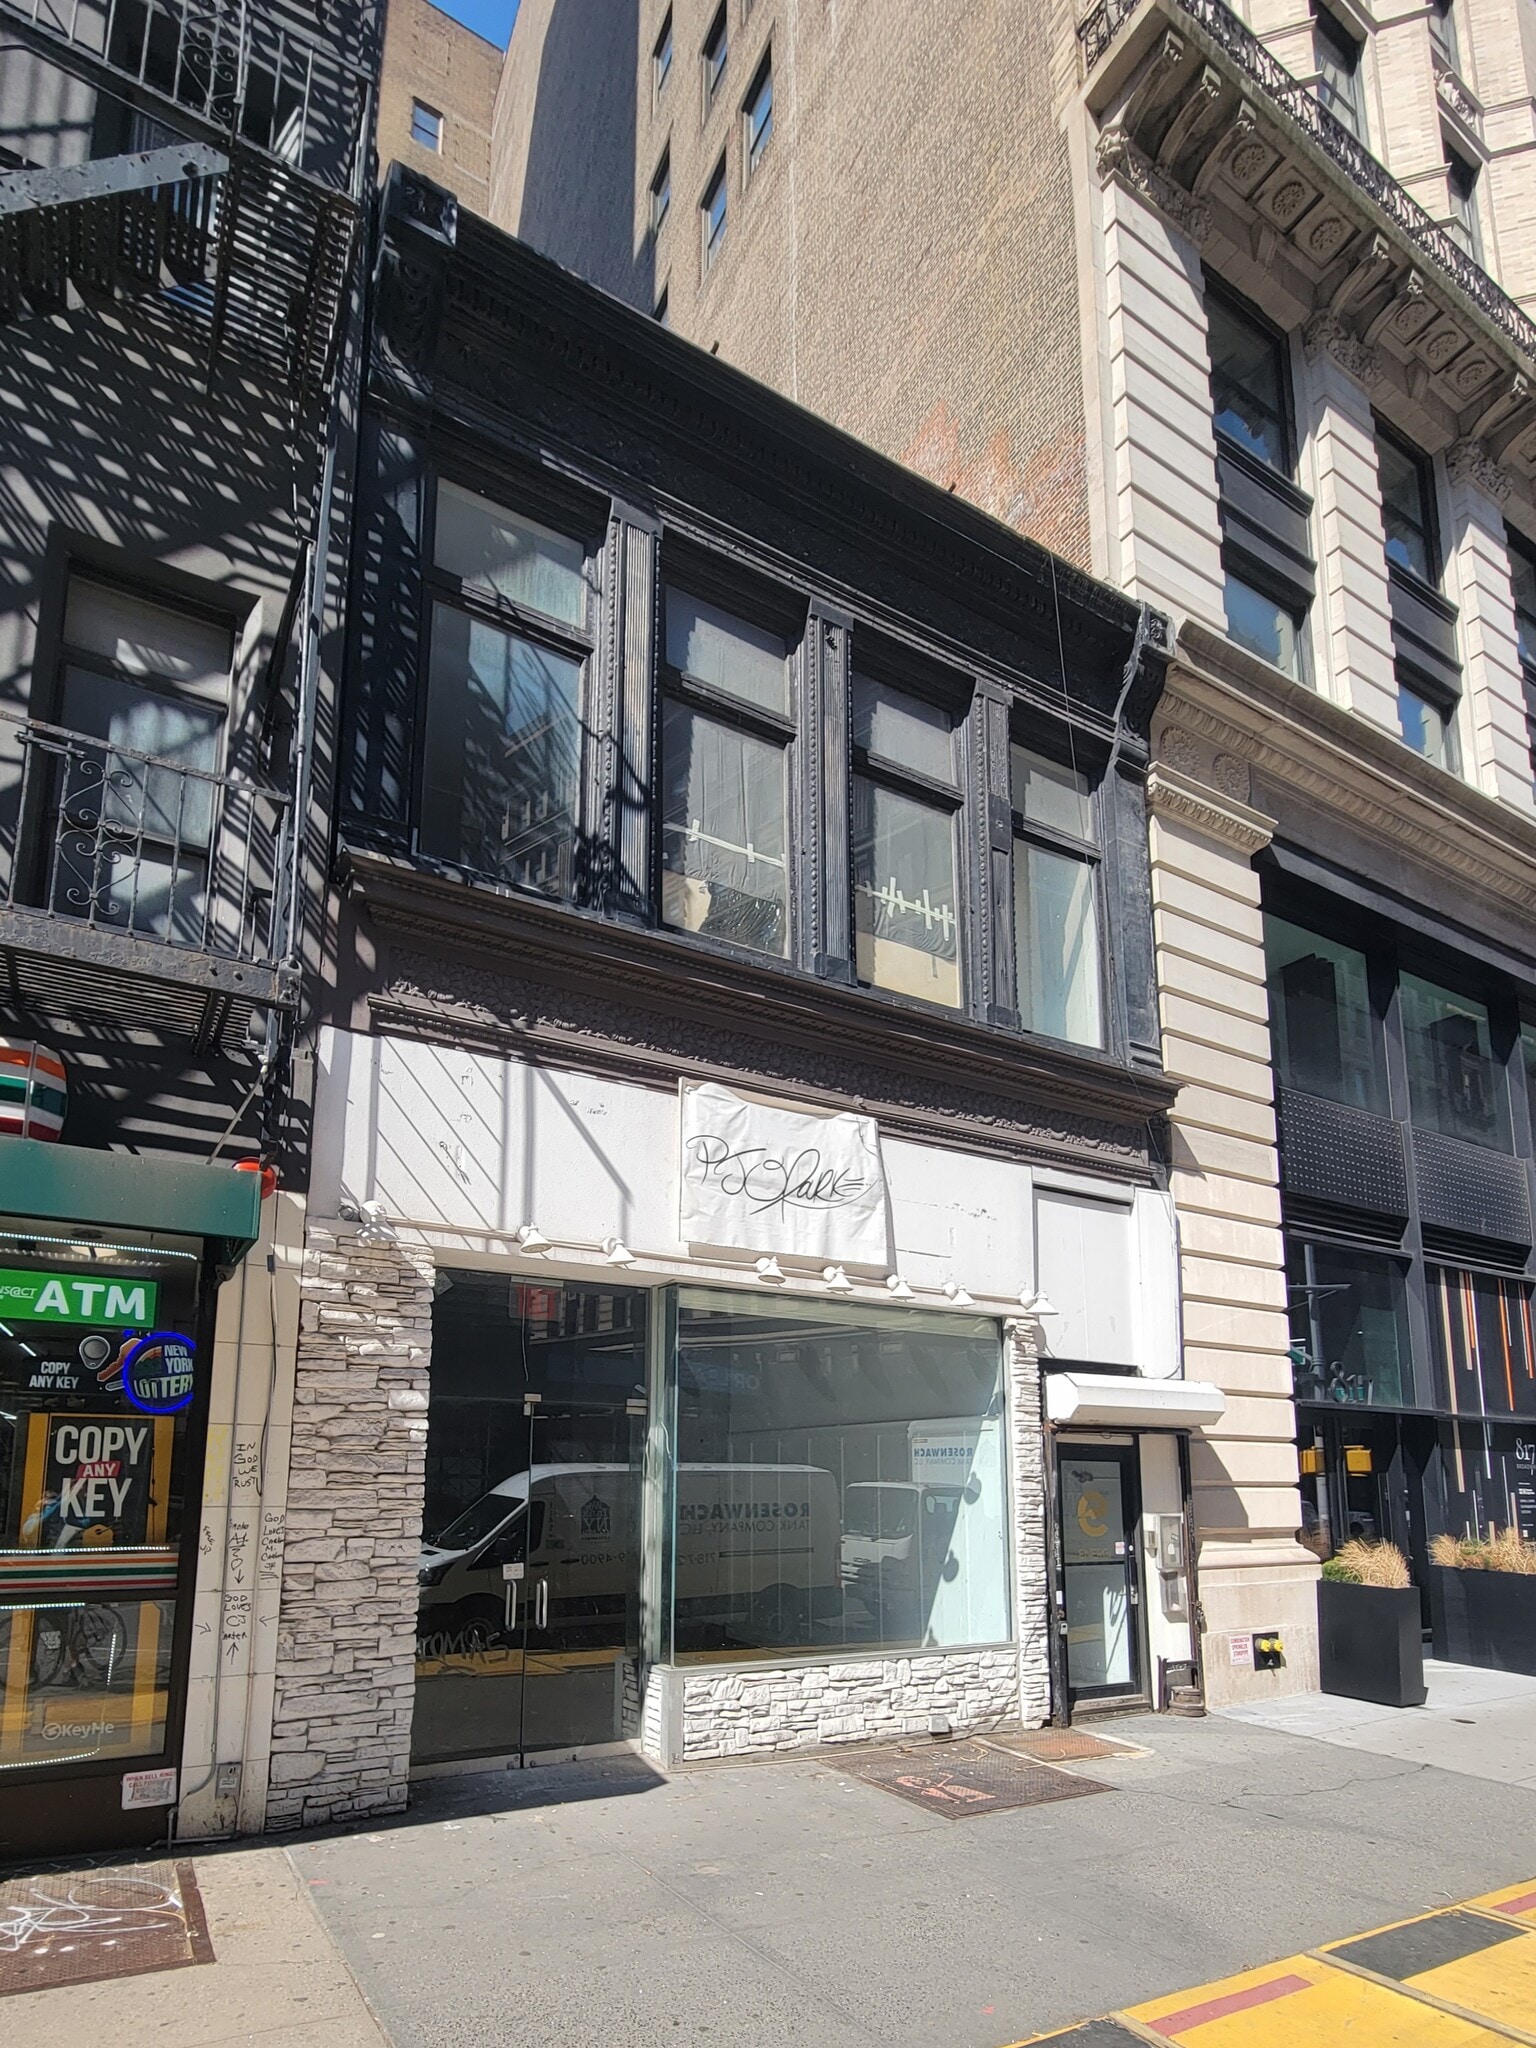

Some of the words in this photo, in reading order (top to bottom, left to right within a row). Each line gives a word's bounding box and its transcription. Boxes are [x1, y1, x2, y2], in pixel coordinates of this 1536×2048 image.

[34, 1280, 145, 1321] ATM
[164, 1345, 188, 1357] NEW
[40, 1361, 71, 1375] COPY
[28, 1375, 55, 1388] ANY
[56, 1376, 80, 1389] KEY
[55, 1425, 148, 1464] COPY
[235, 1441, 256, 1451] IN
[233, 1453, 258, 1464] GOD
[1515, 1437, 1536, 1475] 817
[82, 1463, 116, 1477] ANY
[238, 1465, 258, 1475] WE
[60, 1477, 133, 1518] KEY
[61, 1721, 115, 1739] KeyMe
